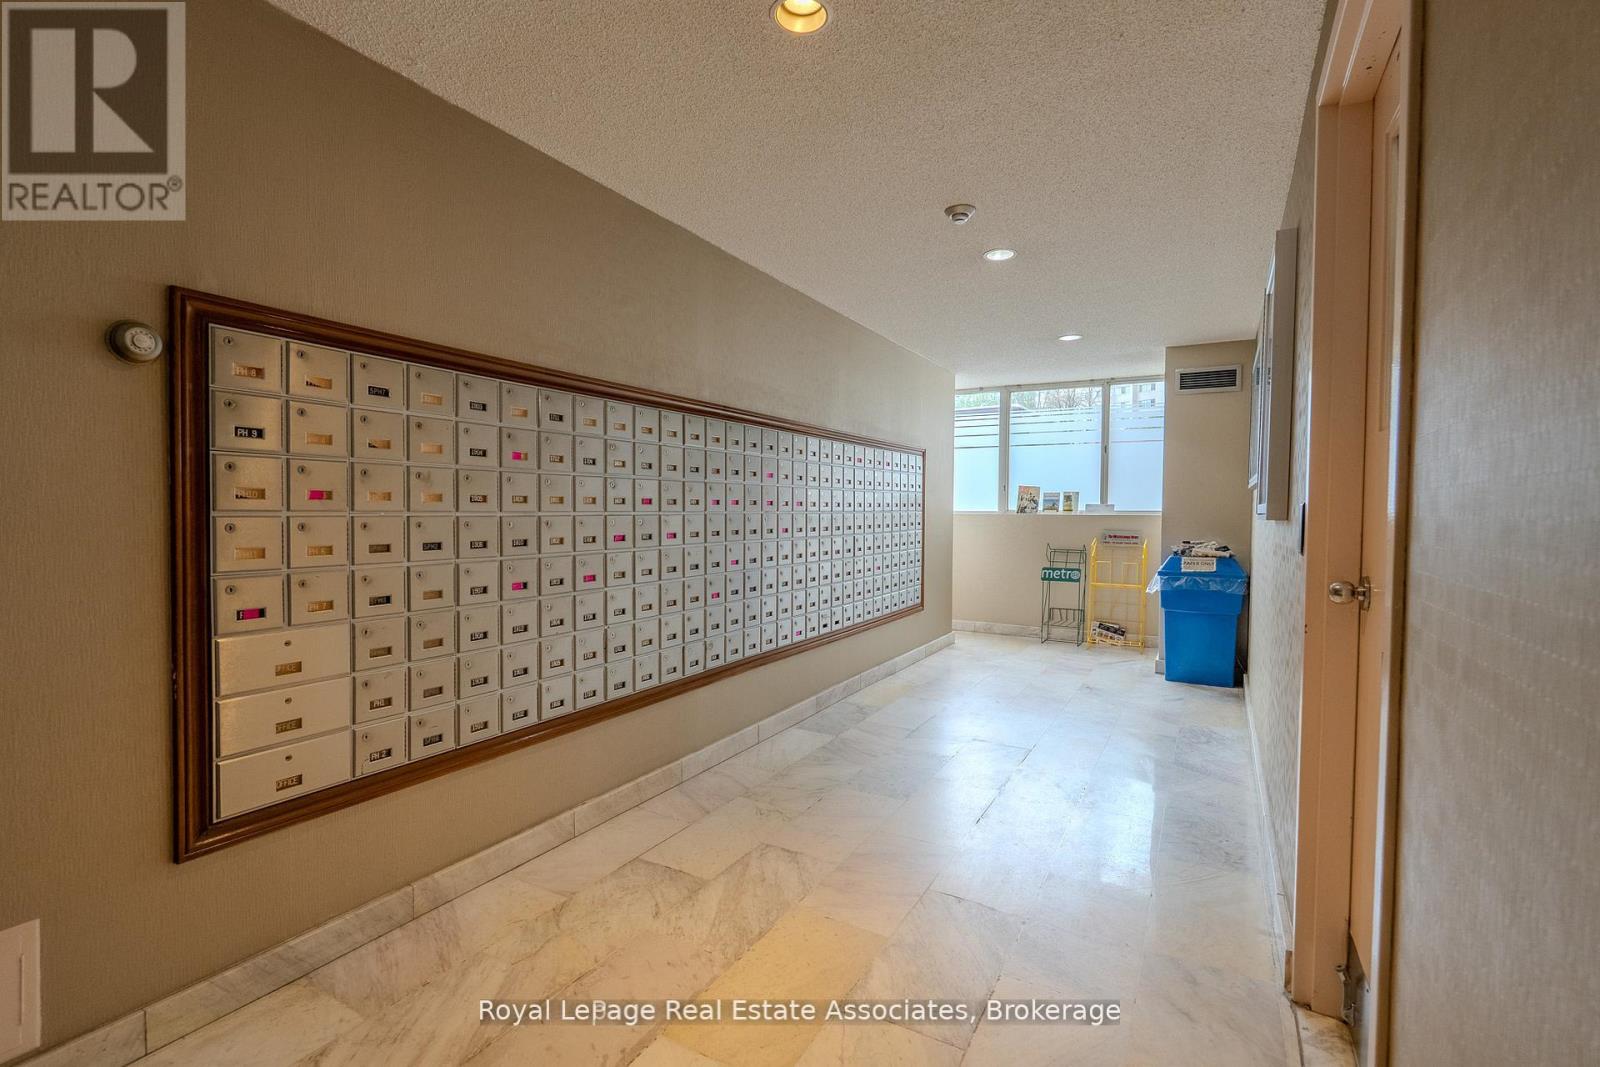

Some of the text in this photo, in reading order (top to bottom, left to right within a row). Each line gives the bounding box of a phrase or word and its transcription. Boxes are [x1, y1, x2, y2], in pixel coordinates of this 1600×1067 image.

[237, 428, 257, 438] PH 9
[1041, 568, 1081, 580] metro
[370, 751, 379, 760] PH
[277, 776, 299, 790] OFFICE
